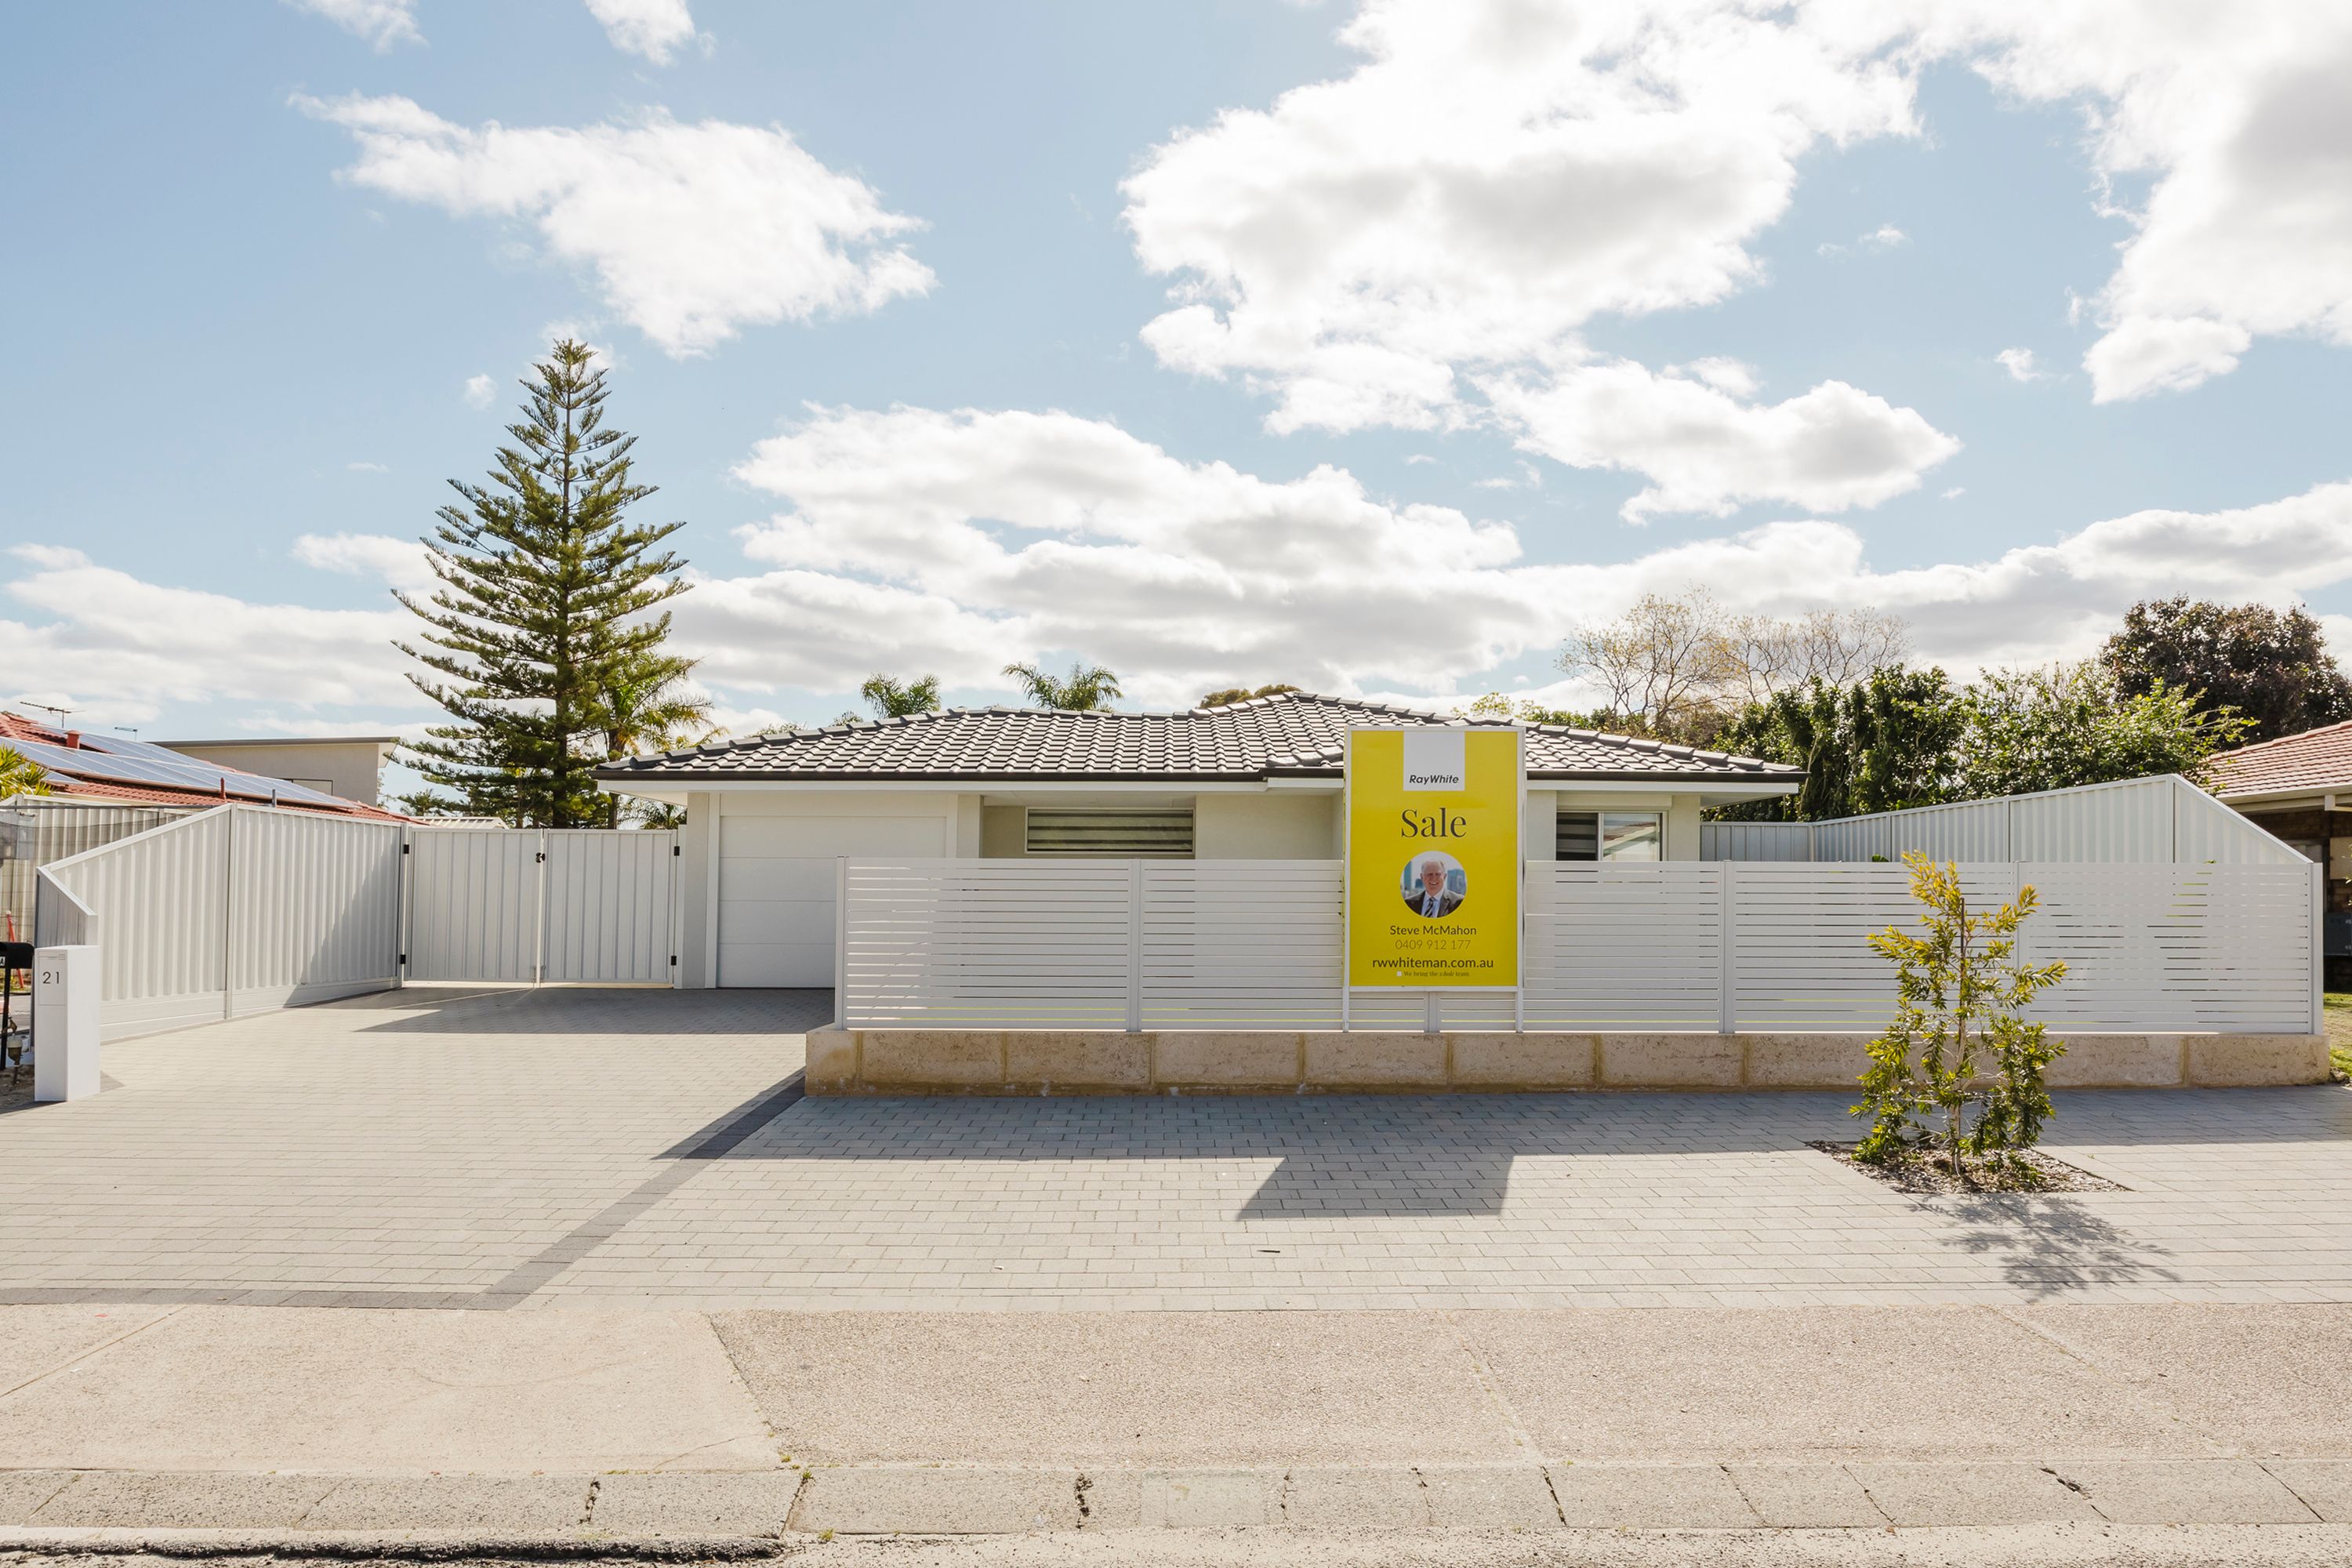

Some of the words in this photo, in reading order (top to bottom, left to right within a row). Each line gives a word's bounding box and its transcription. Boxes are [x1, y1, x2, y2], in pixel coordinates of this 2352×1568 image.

[1401, 807, 1467, 837] Sale
[1389, 925, 1420, 935] Steve
[1423, 925, 1477, 935] McMahon
[1395, 939, 1423, 949] 0409
[1427, 939, 1446, 949] 912
[1451, 939, 1471, 949] 177
[1372, 956, 1494, 968] rwwhiteman.com.au
[42, 971, 60, 984] 21
